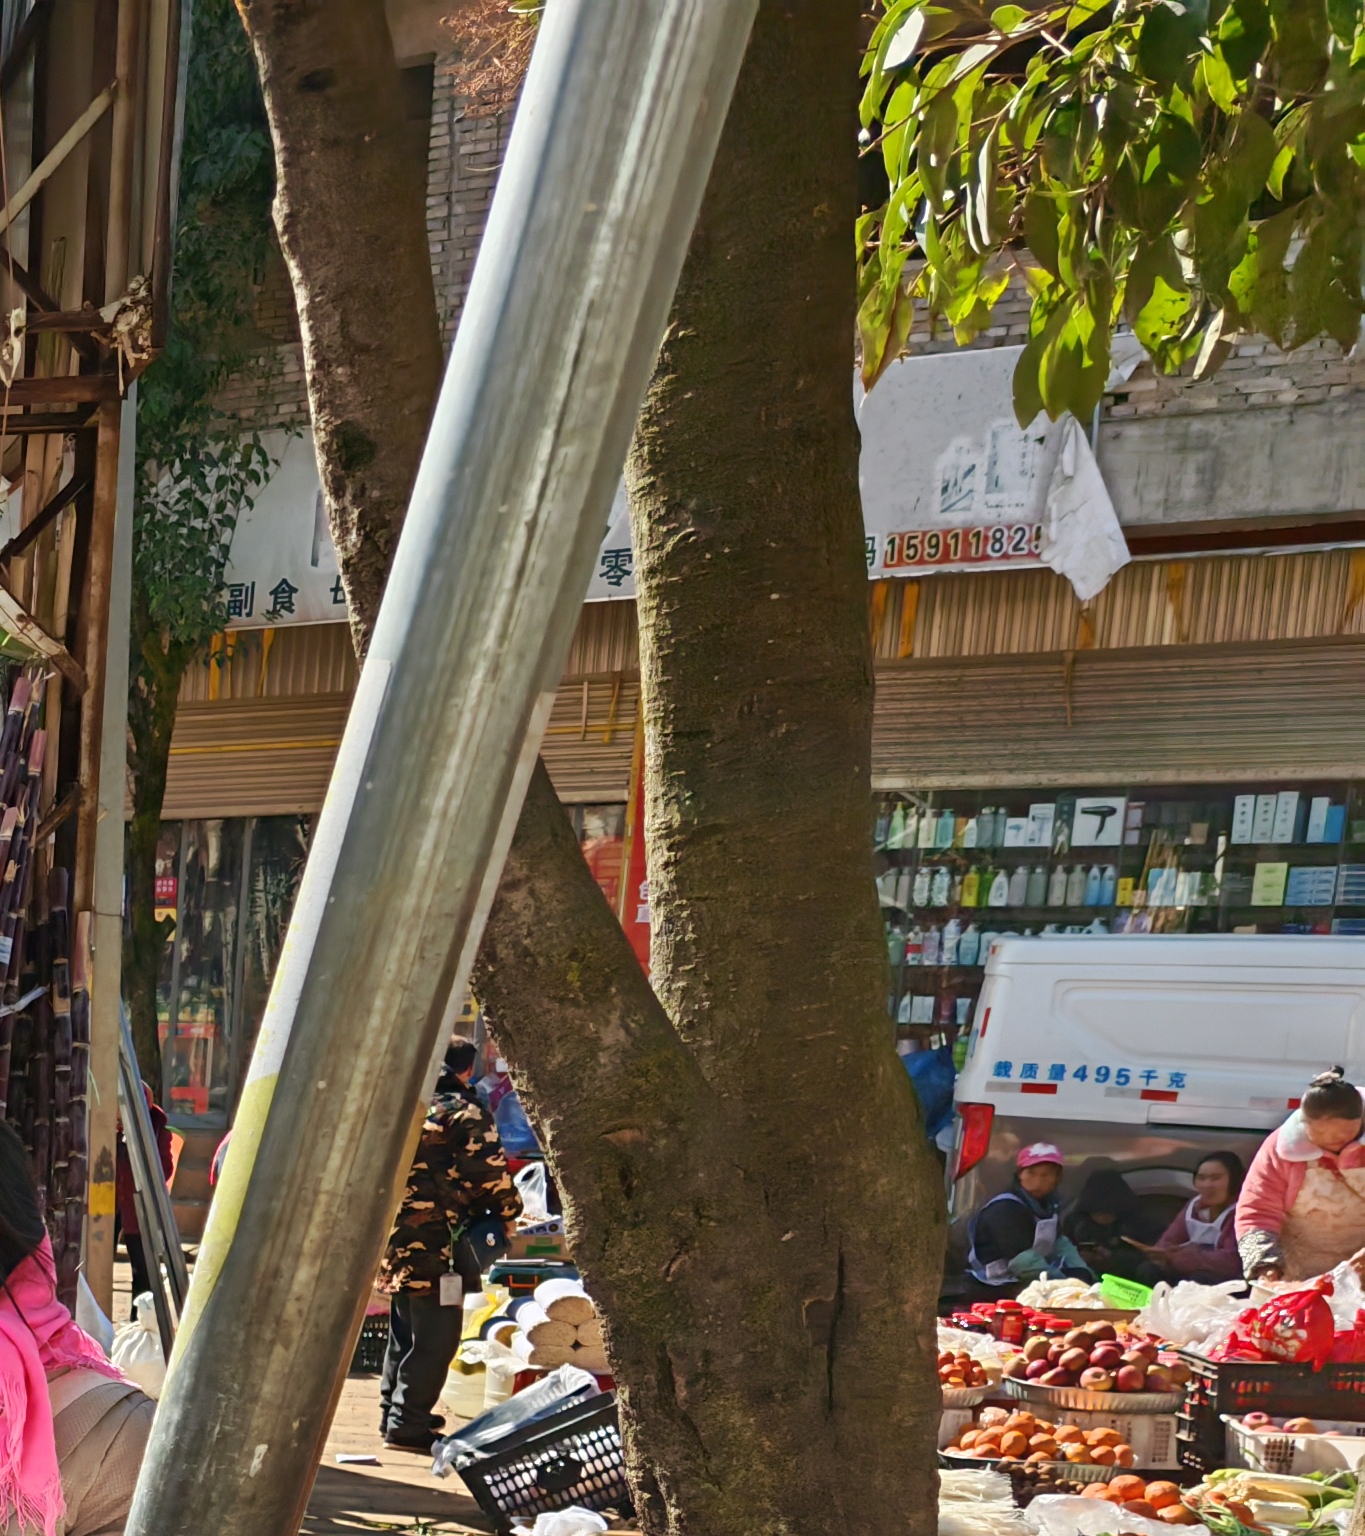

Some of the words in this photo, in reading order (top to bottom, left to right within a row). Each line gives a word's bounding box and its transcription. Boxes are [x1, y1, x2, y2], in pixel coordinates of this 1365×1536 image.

[992, 1060, 1187, 1089] 载质量495千克
